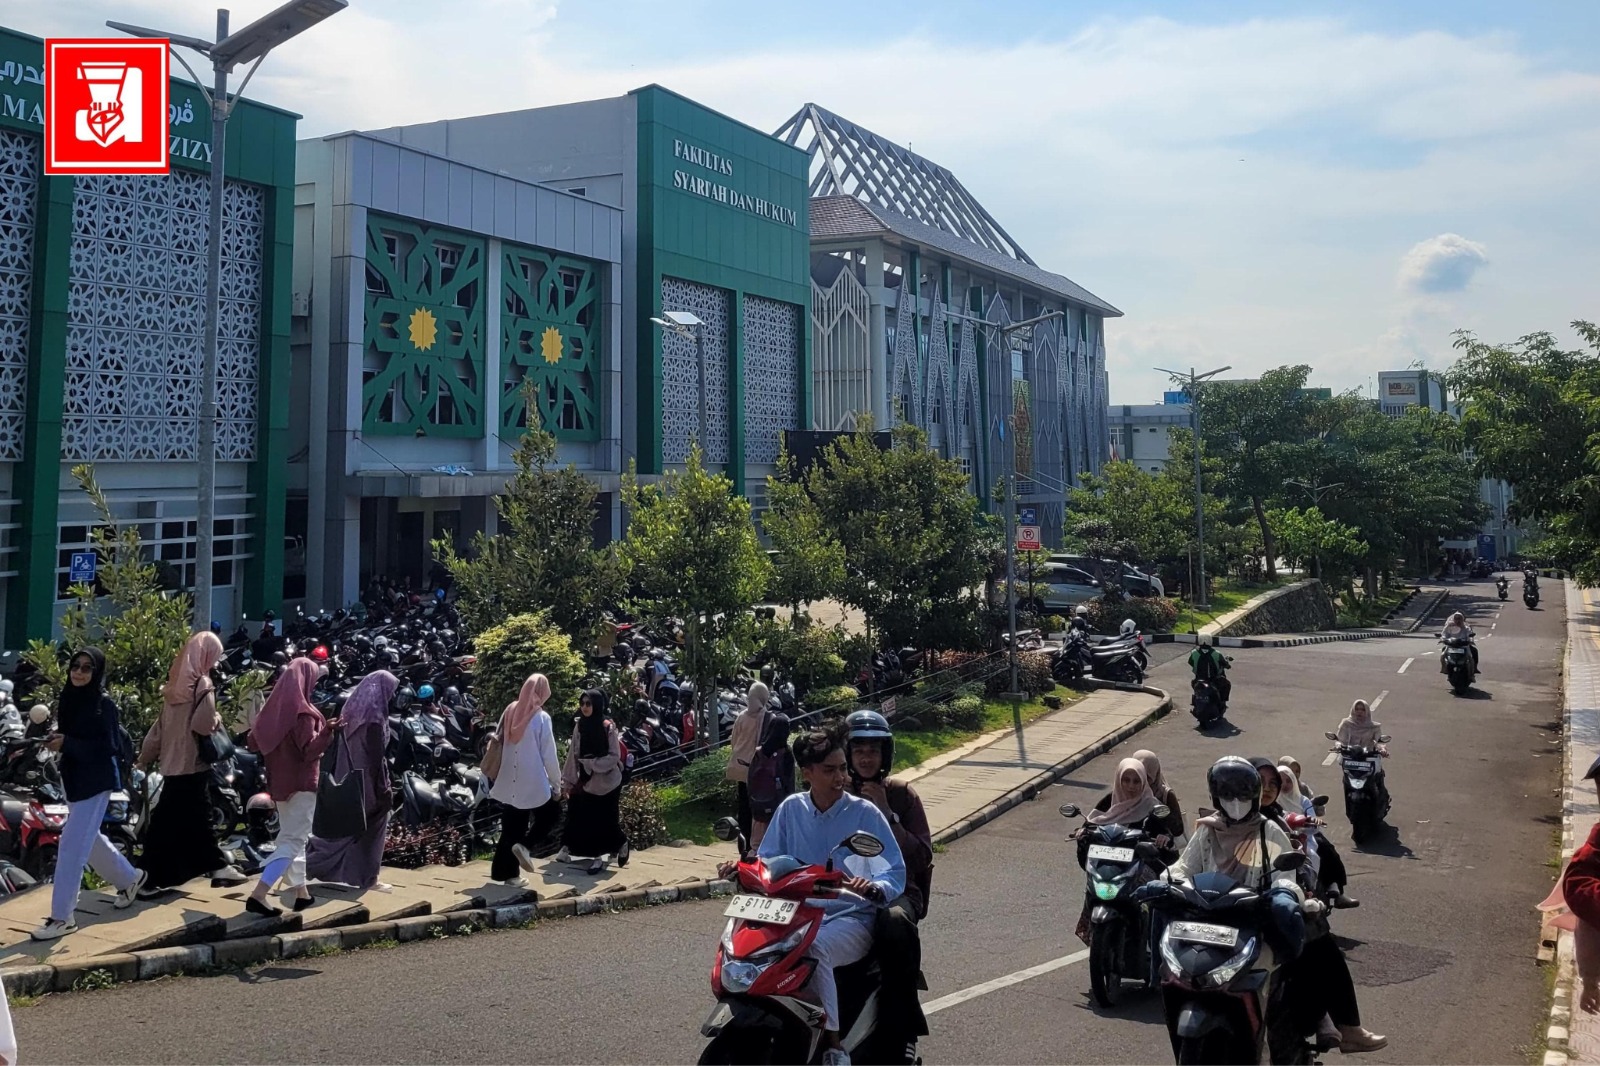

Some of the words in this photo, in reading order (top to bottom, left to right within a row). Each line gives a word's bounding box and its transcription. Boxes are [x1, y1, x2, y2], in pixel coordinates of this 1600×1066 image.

[1, 93, 45, 125] MA
[169, 134, 213, 163] ZIZY
[674, 139, 733, 176] FAKULTAS
[730, 189, 754, 212] DAN
[756, 198, 797, 226] HUKUM
[74, 556, 82, 567] P
[732, 896, 740, 905] G
[745, 897, 773, 909] 6110
